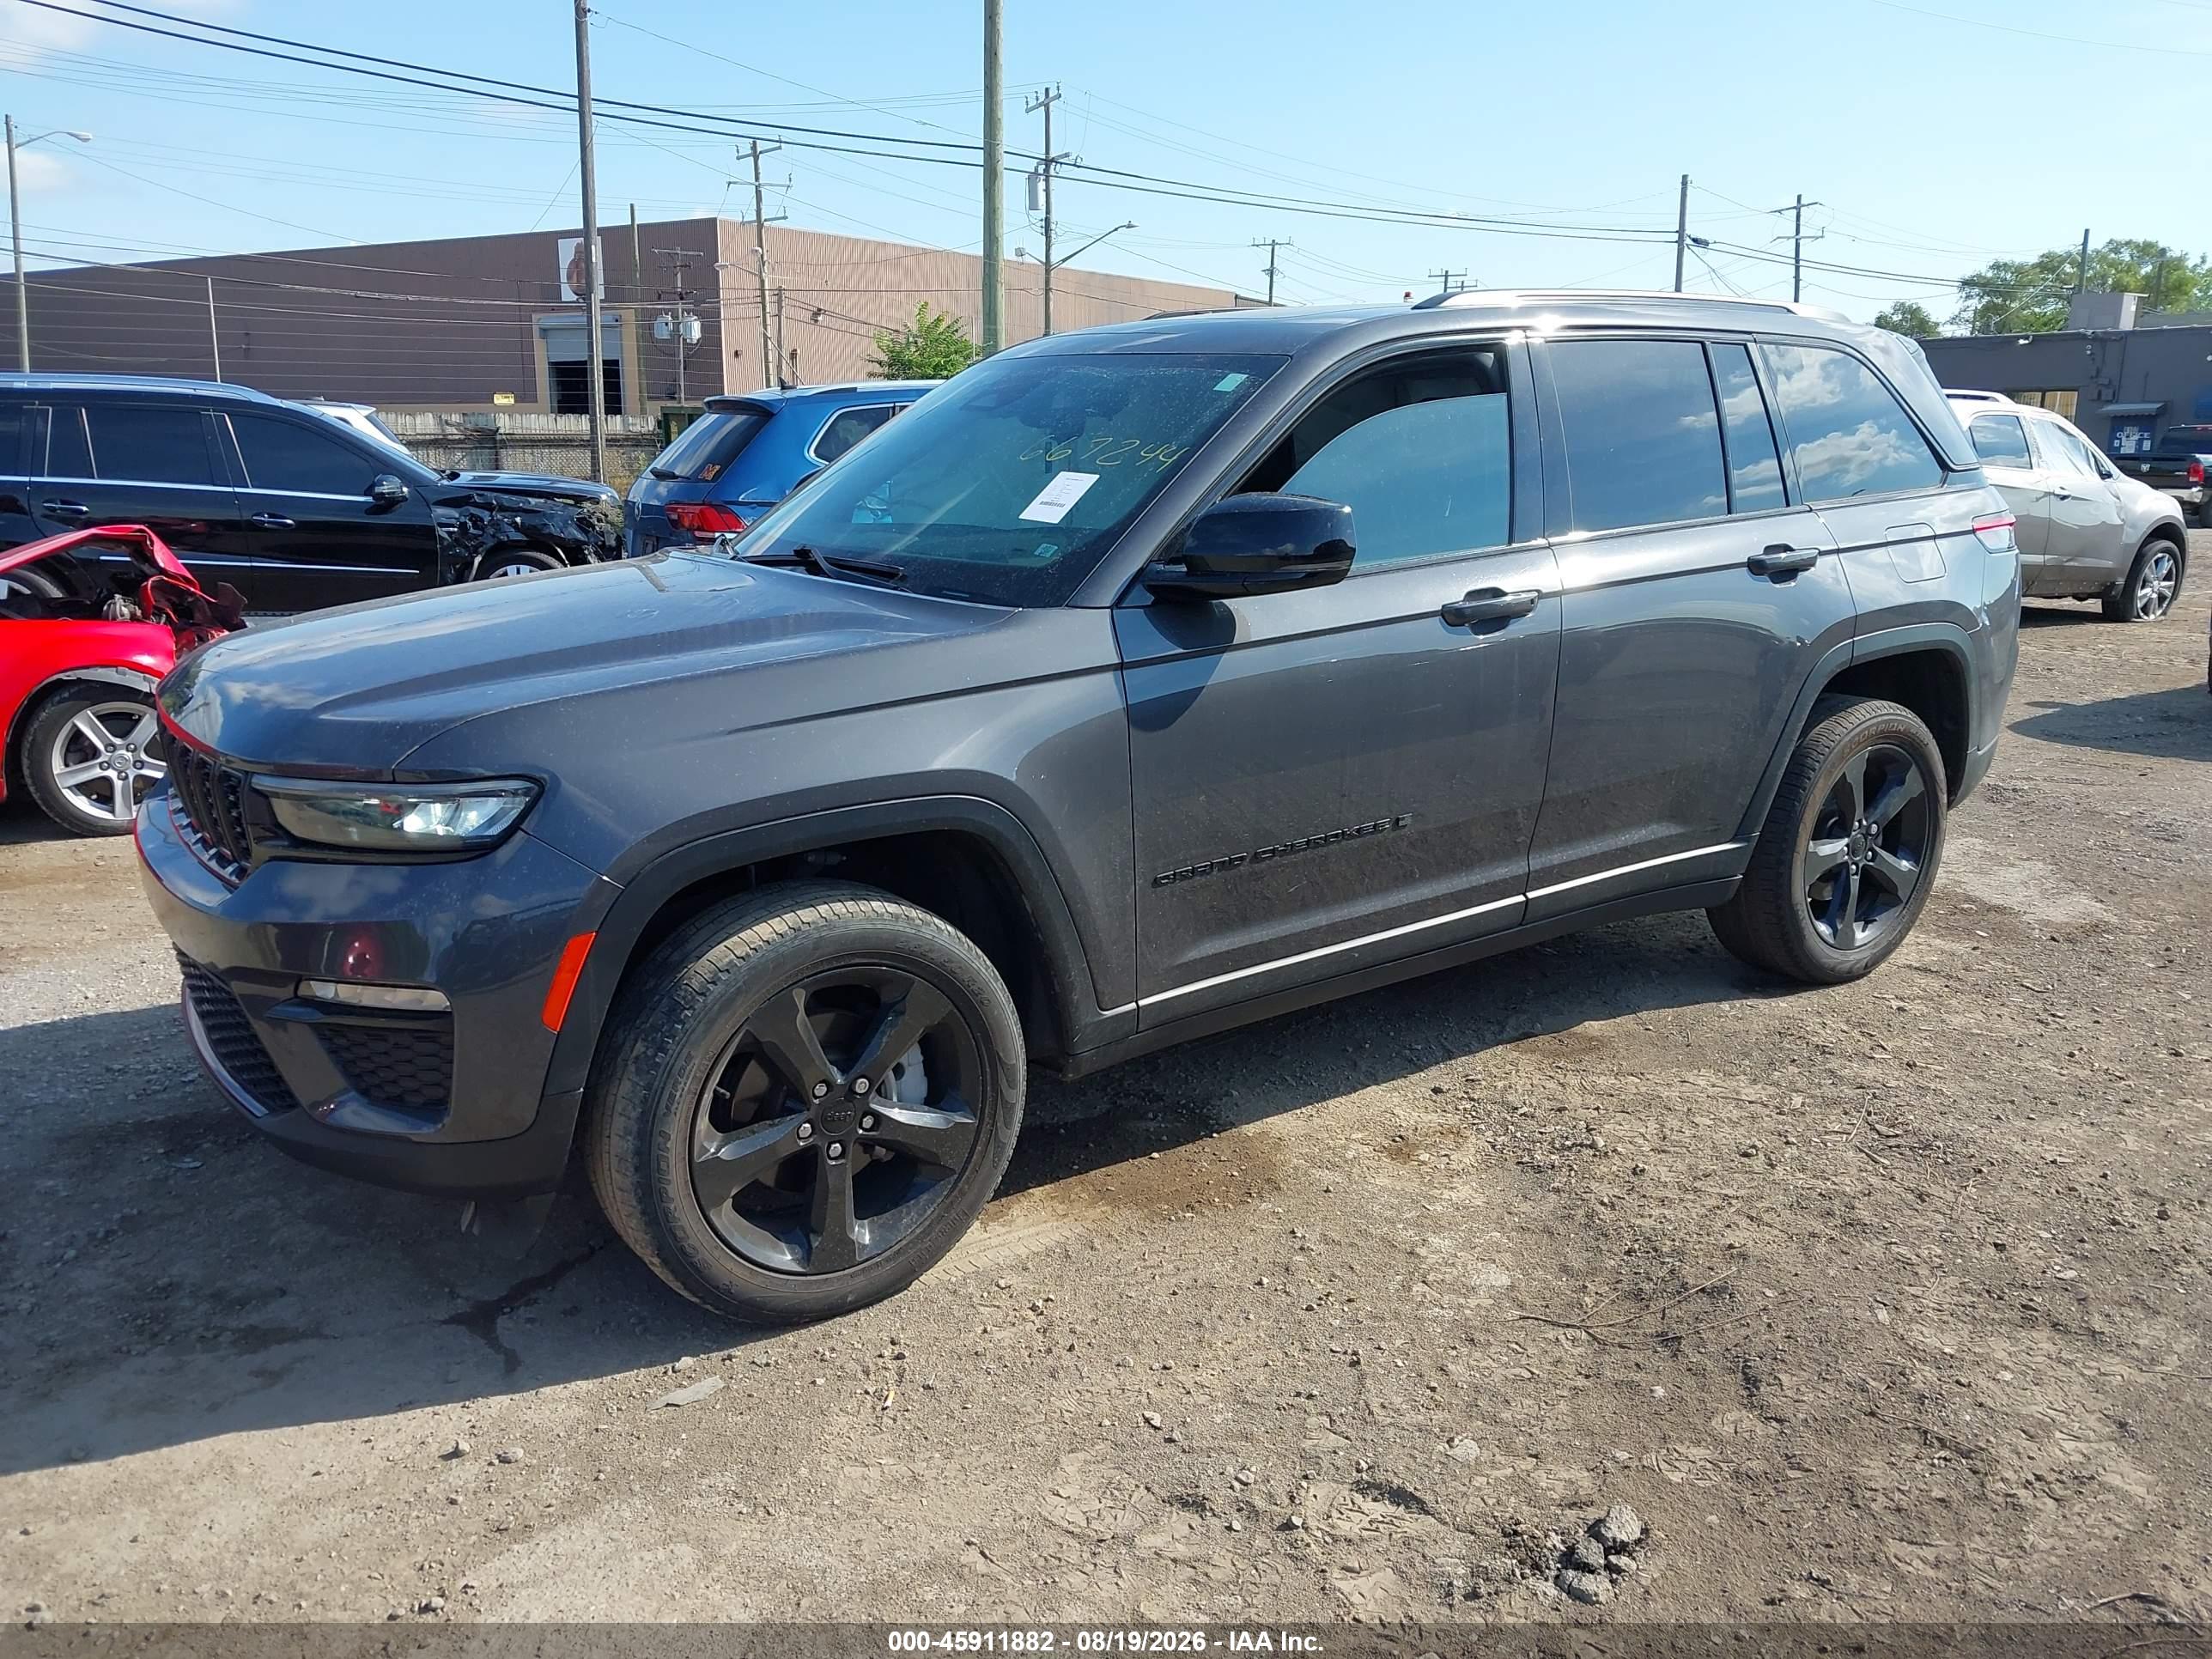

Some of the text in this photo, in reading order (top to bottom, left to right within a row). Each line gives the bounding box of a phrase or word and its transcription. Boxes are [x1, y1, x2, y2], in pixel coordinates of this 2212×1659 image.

[1019, 434, 1190, 472] 667244
[1152, 817, 1391, 888] GRAND CHEROKEE
[657, 1129, 712, 1271] SCORPION
